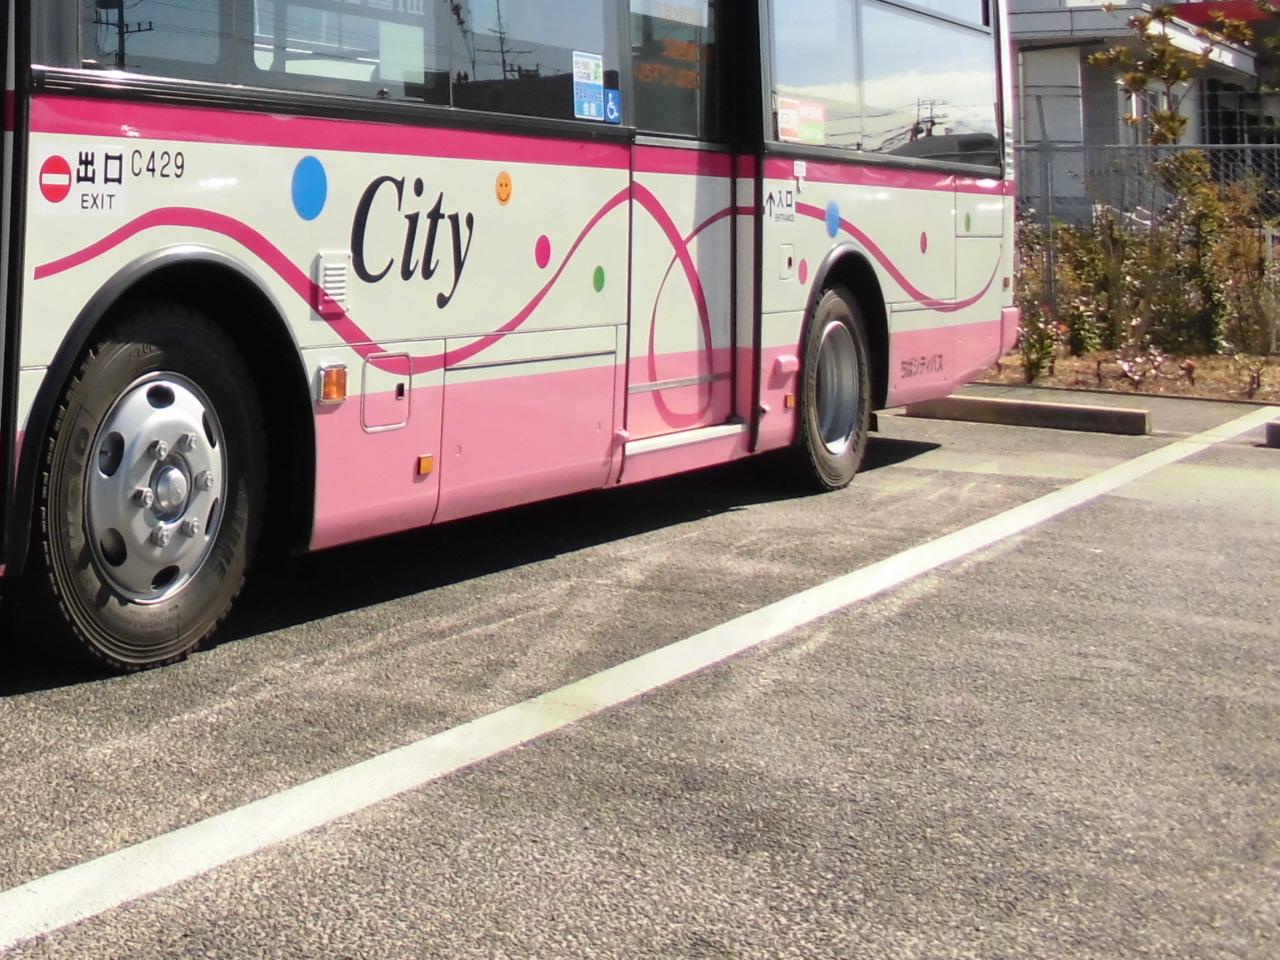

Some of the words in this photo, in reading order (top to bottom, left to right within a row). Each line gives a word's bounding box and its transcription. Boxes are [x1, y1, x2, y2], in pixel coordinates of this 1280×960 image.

[76, 151, 123, 185] 出口
[131, 149, 185, 178] C429
[80, 194, 116, 210] EXIT
[777, 190, 793, 208] 入口
[351, 175, 474, 309] City
